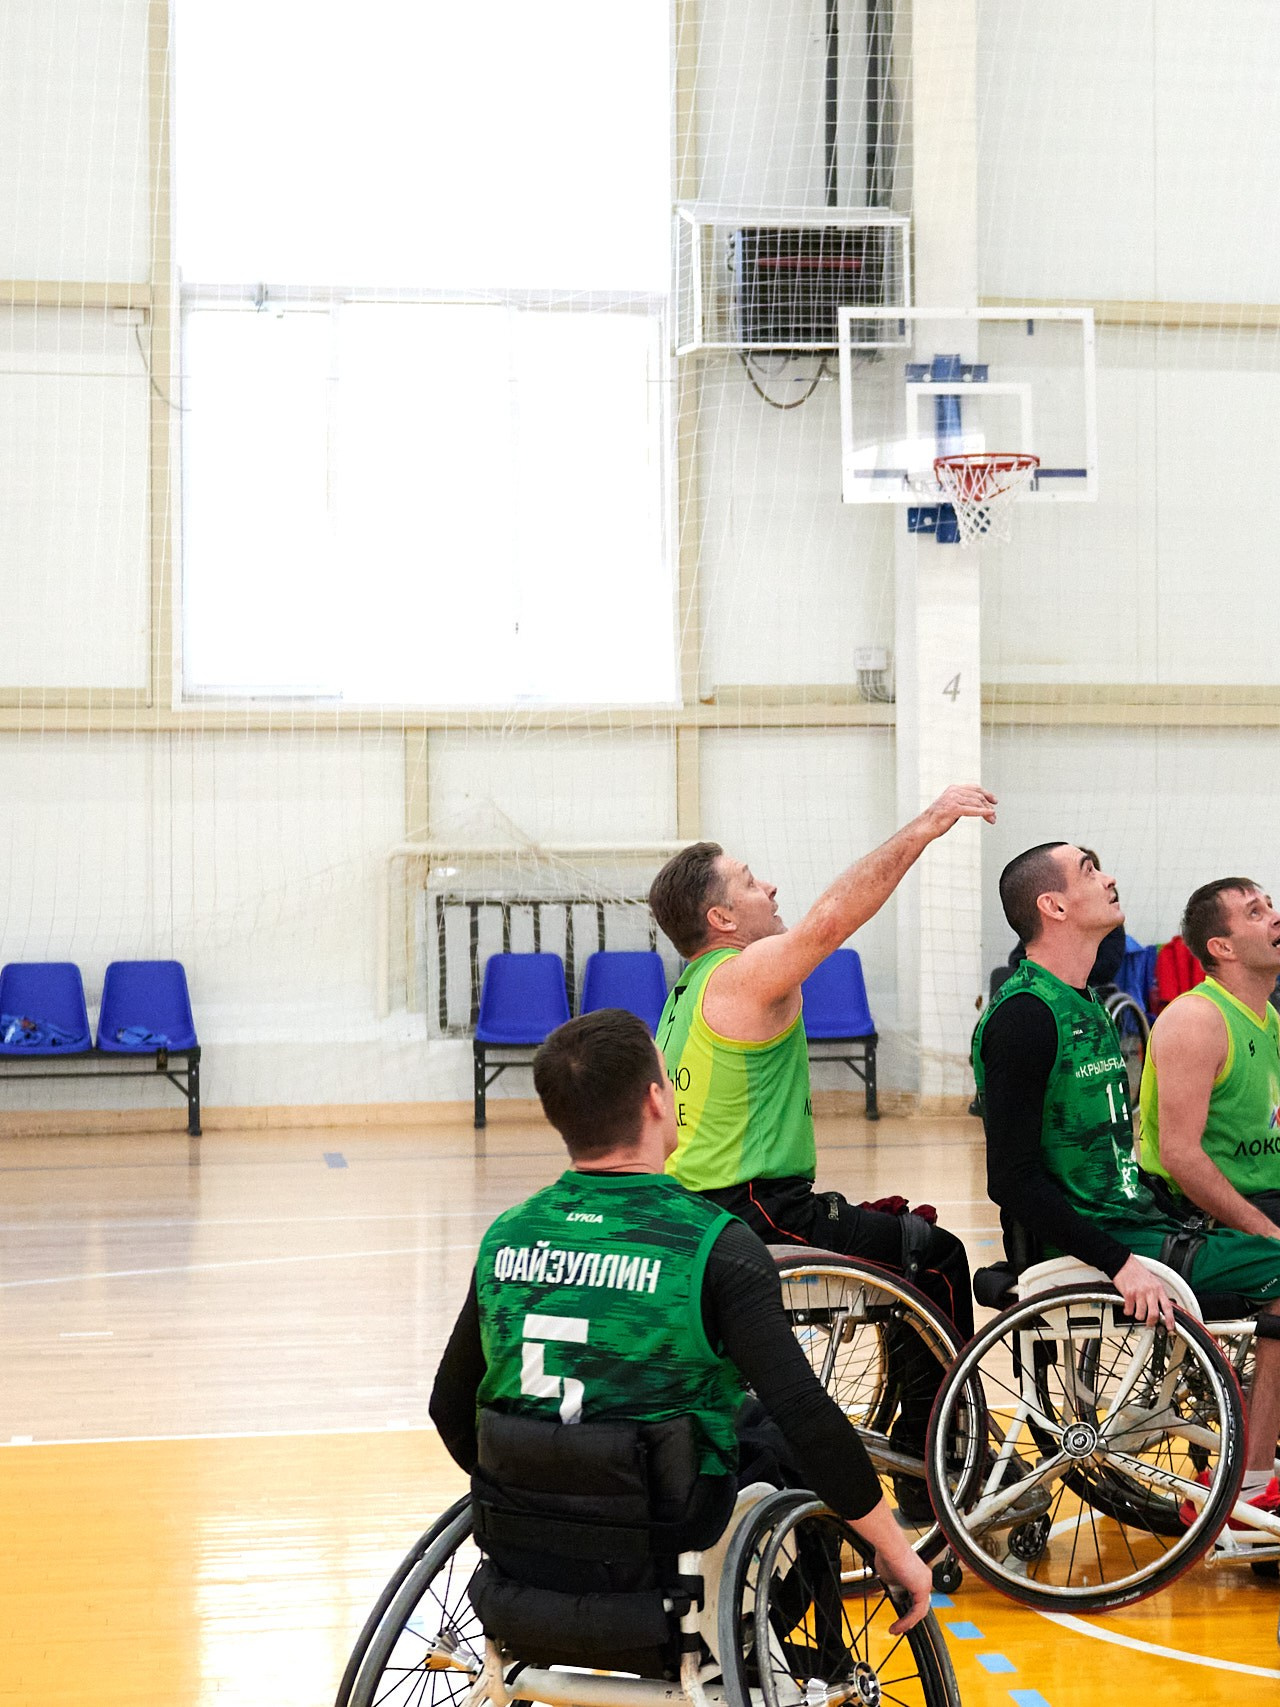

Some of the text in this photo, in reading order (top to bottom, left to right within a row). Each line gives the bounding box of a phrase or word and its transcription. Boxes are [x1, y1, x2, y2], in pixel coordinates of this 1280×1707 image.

[942, 672, 962, 702] 4
[565, 1211, 604, 1224] LYKIA
[494, 1240, 662, 1294] ФАЙЗУЛЛИН
[520, 1313, 589, 1425] 5
